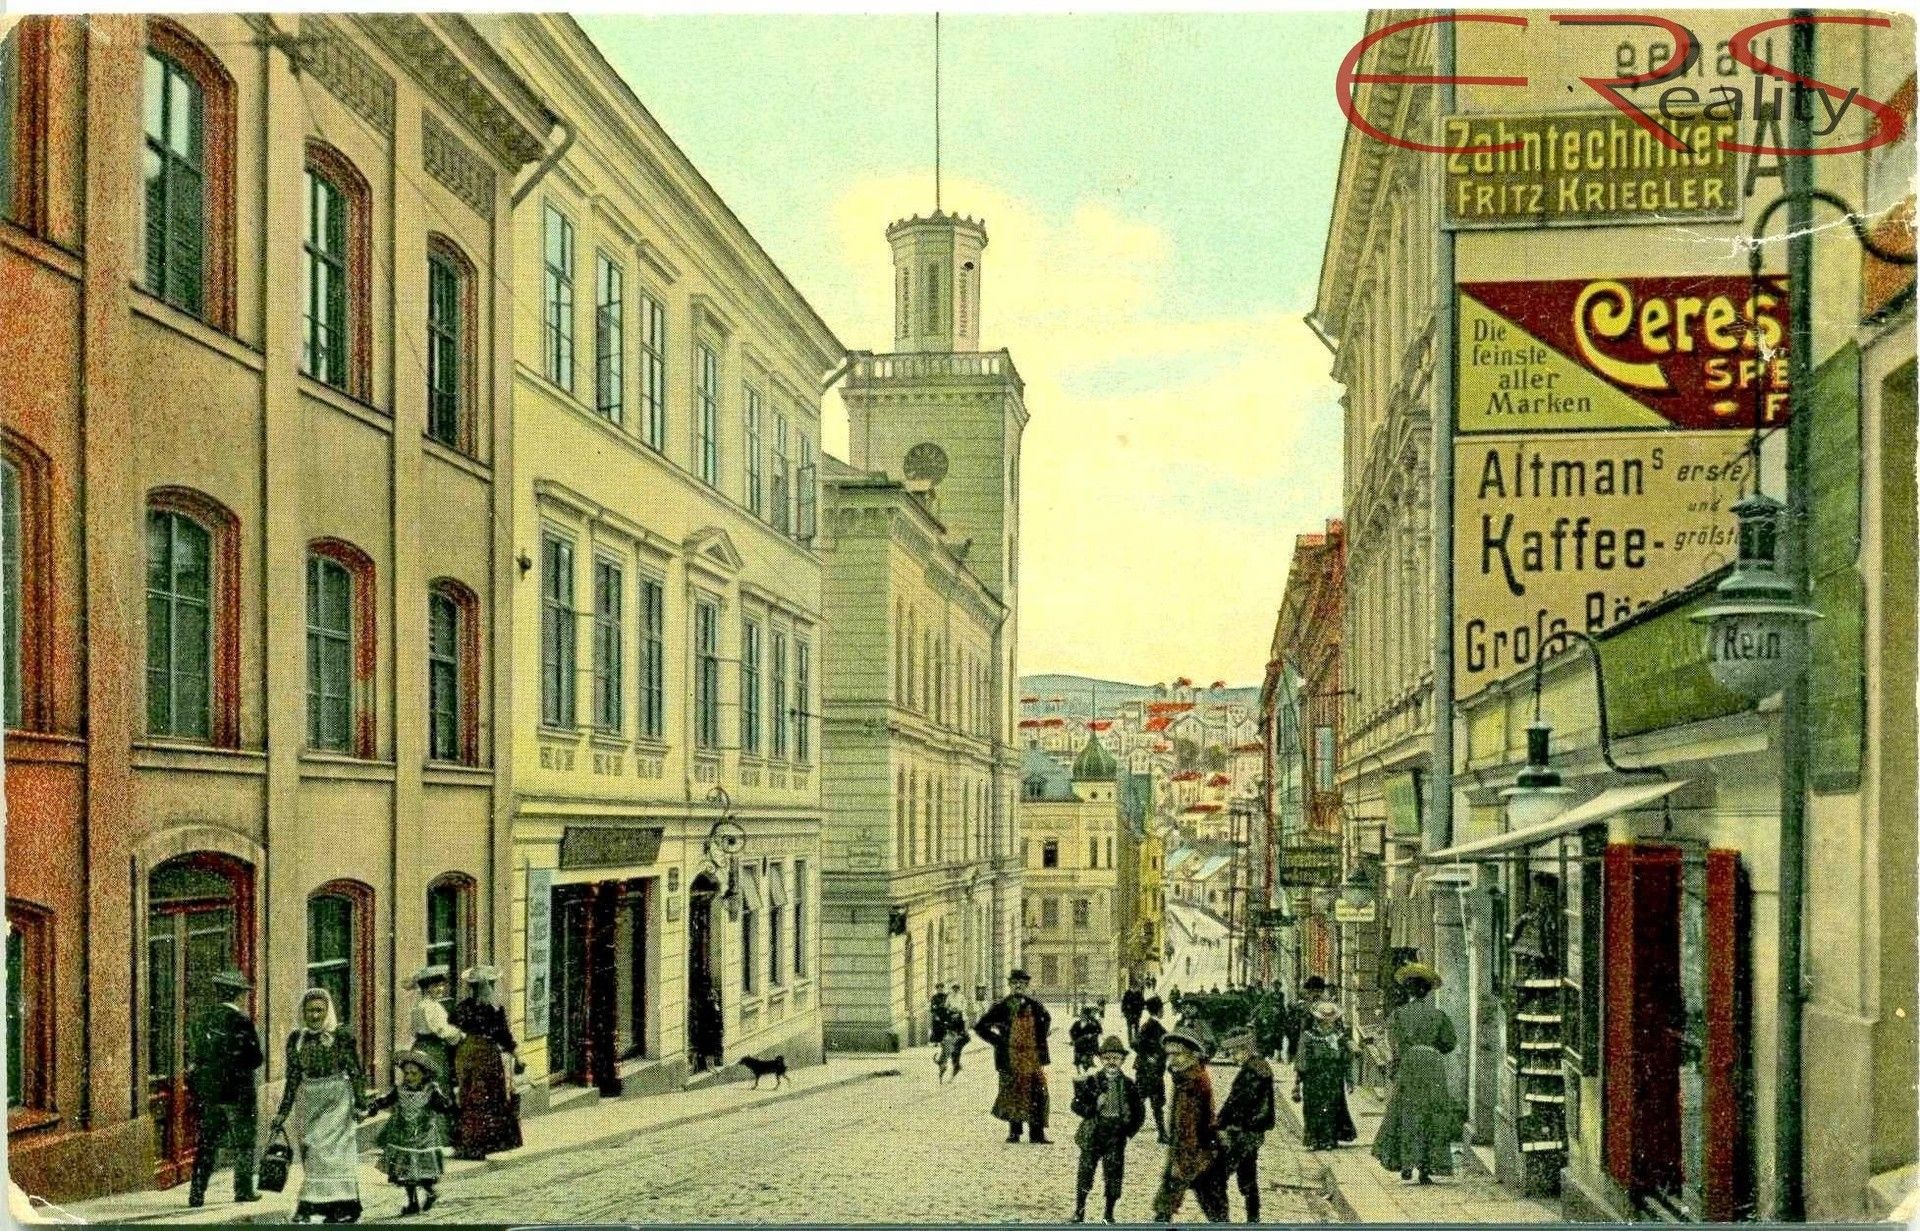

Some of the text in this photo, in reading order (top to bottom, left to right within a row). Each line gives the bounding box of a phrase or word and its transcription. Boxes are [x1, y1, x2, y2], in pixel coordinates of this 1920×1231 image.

[1447, 119, 1735, 174] Zahntechniker
[1457, 180, 1544, 215] FRITZ
[1473, 318, 1506, 342] Die
[1574, 280, 1782, 391] Ceres
[1472, 344, 1548, 367] feinste
[1499, 368, 1560, 391] aller
[1485, 391, 1592, 415] Marken
[1676, 462, 1743, 482] erste
[1481, 512, 1664, 597] Kaffee-
[1723, 621, 1782, 662] Rein
